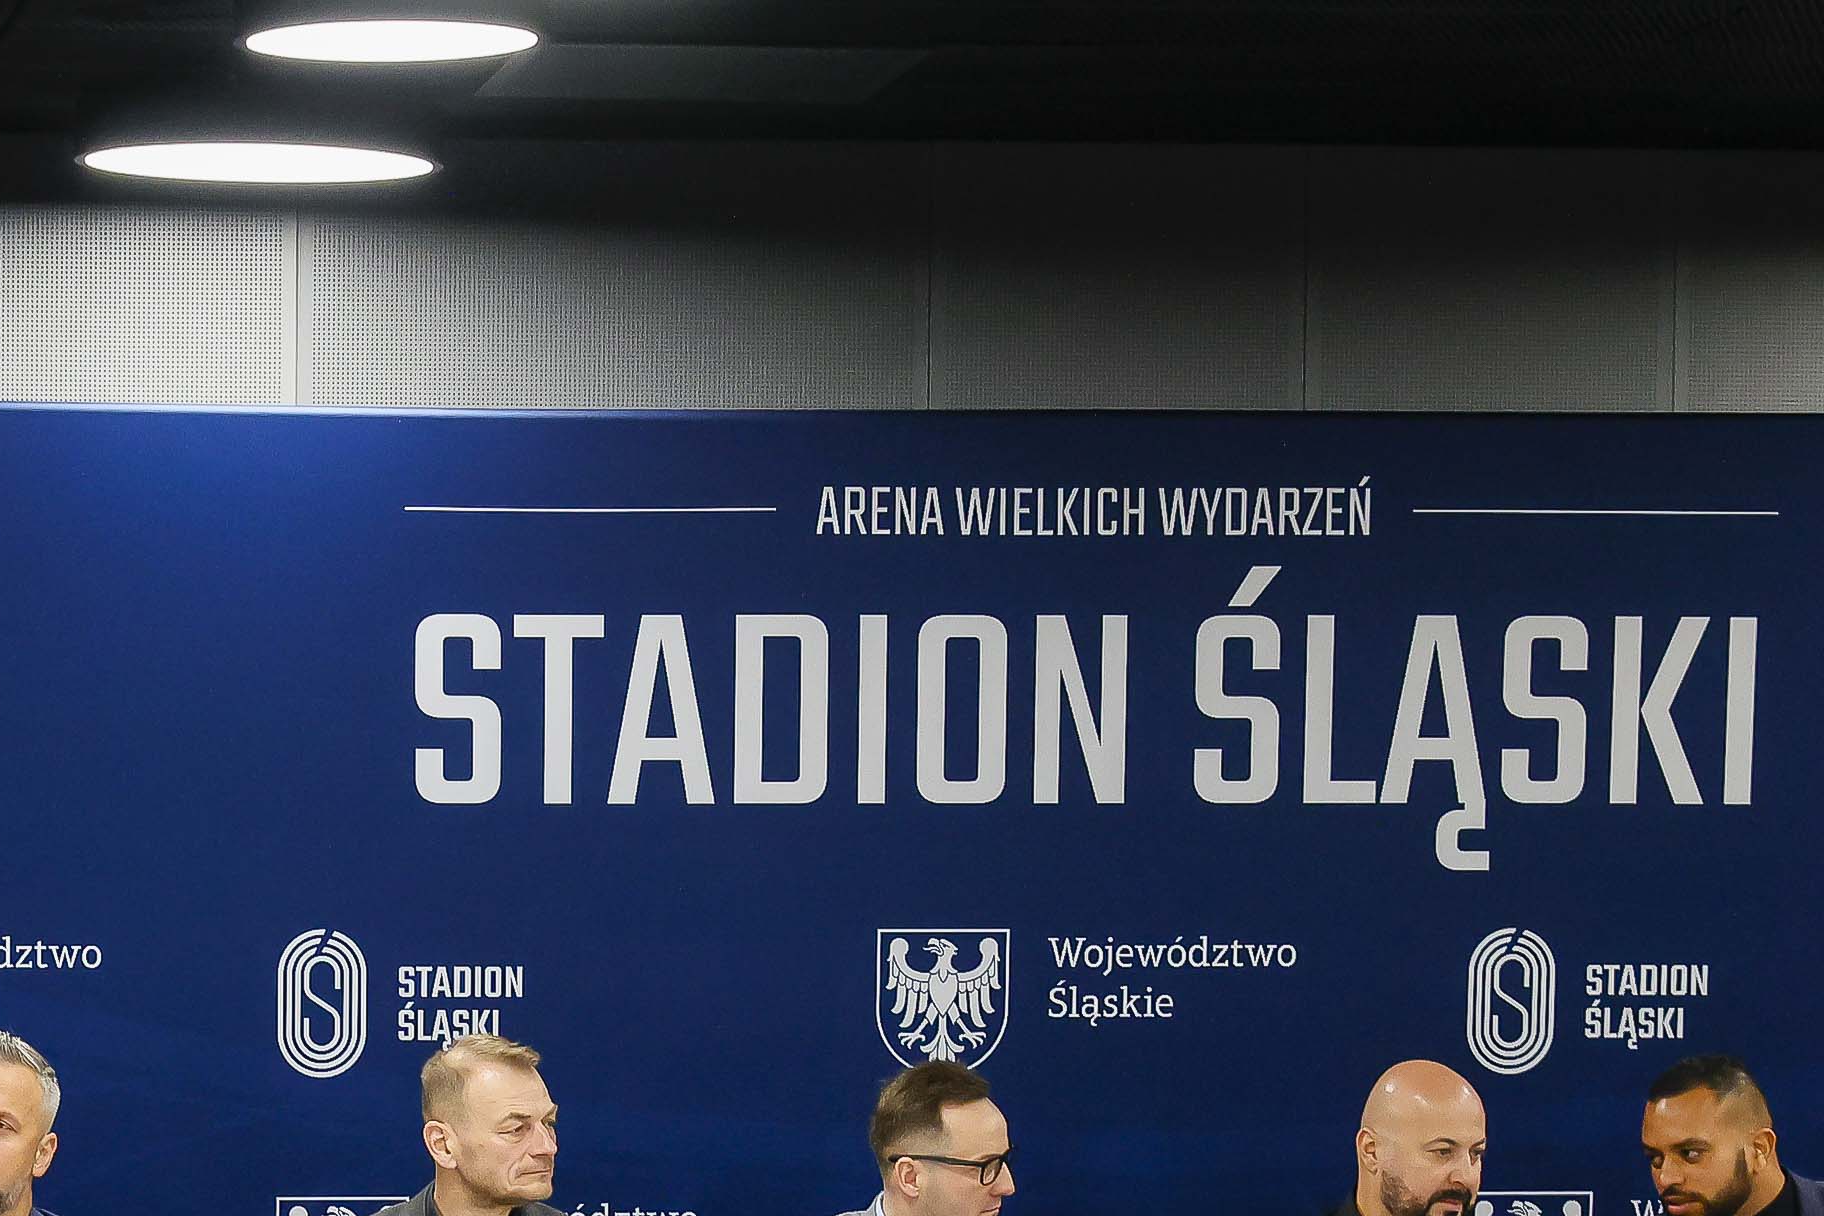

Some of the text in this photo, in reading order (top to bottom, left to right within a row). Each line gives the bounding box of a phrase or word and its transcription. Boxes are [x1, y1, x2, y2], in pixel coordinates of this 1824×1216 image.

[816, 476, 1371, 536] ARENA WIELKICH WYDARZEŃ
[414, 565, 1758, 872] STADION ŚLĄSKI
[1048, 936, 1297, 973] Województwo
[398, 965, 524, 998] STADION
[1585, 964, 1709, 996] STADION
[398, 1001, 499, 1051] ŚLĄSKI
[1048, 985, 1174, 1027] Śląskie
[1584, 1003, 1684, 1050] ŚLĄSKI
